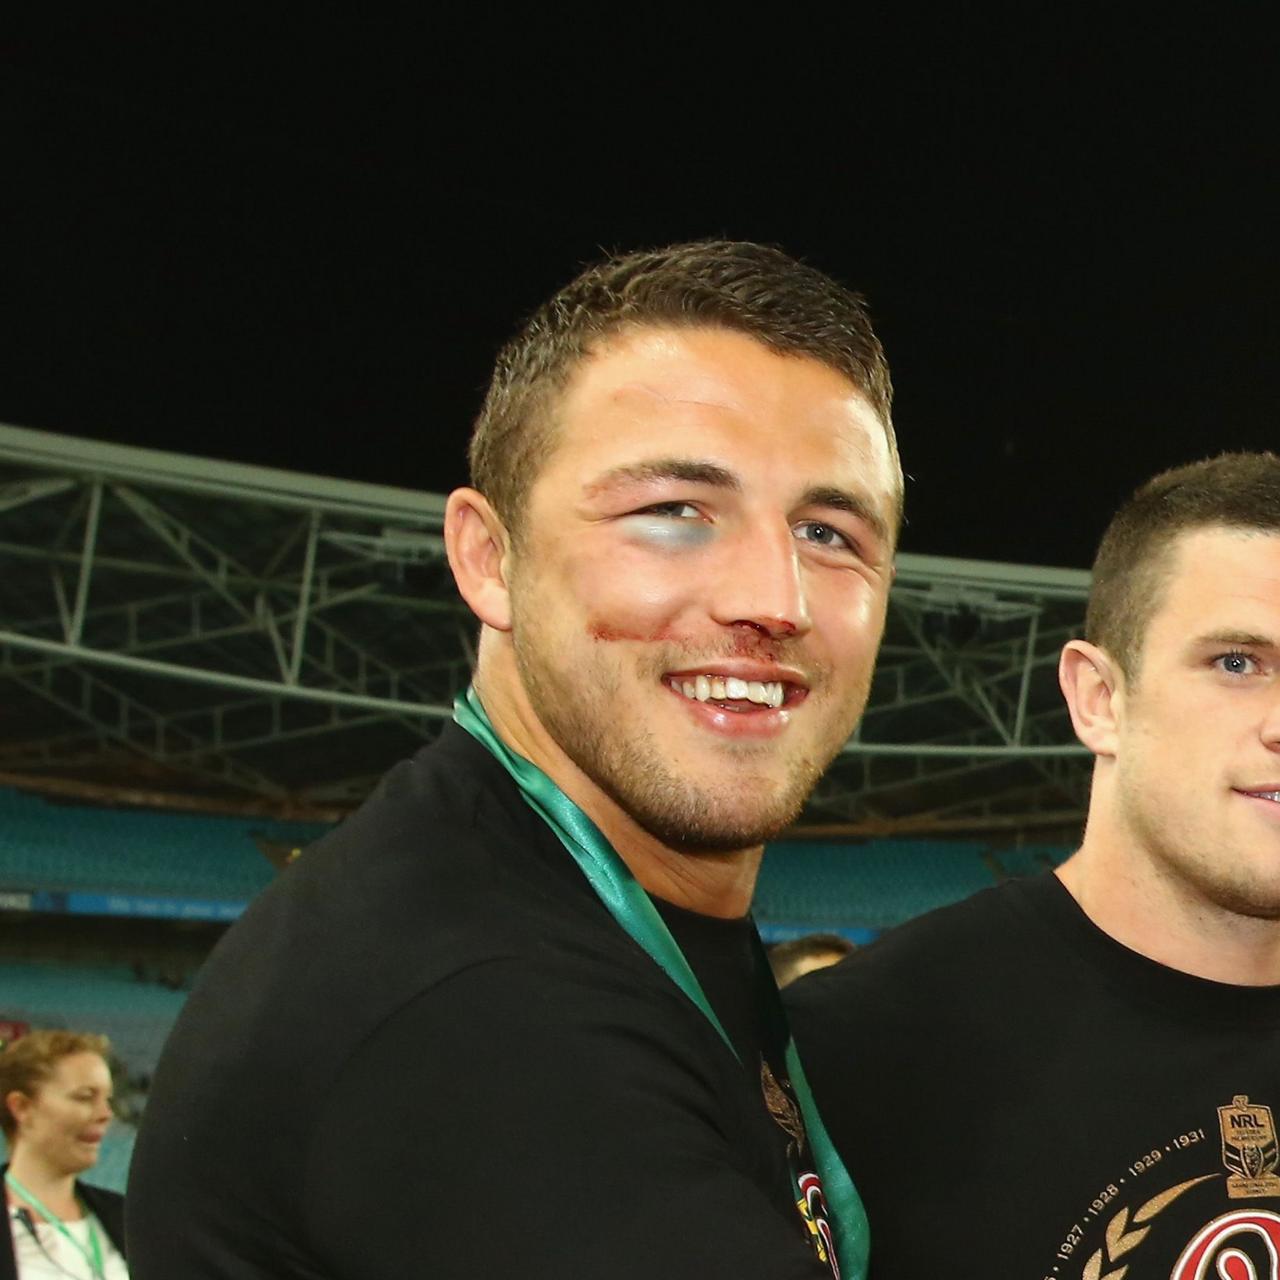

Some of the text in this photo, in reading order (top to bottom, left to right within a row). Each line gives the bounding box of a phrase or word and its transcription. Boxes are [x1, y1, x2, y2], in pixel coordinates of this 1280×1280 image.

[1230, 1114, 1265, 1128] NRL
[1056, 1224, 1085, 1260] 1927
[1087, 1183, 1120, 1216] 1928
[1128, 1149, 1163, 1177] 1929
[1172, 1128, 1206, 1150] 1931
